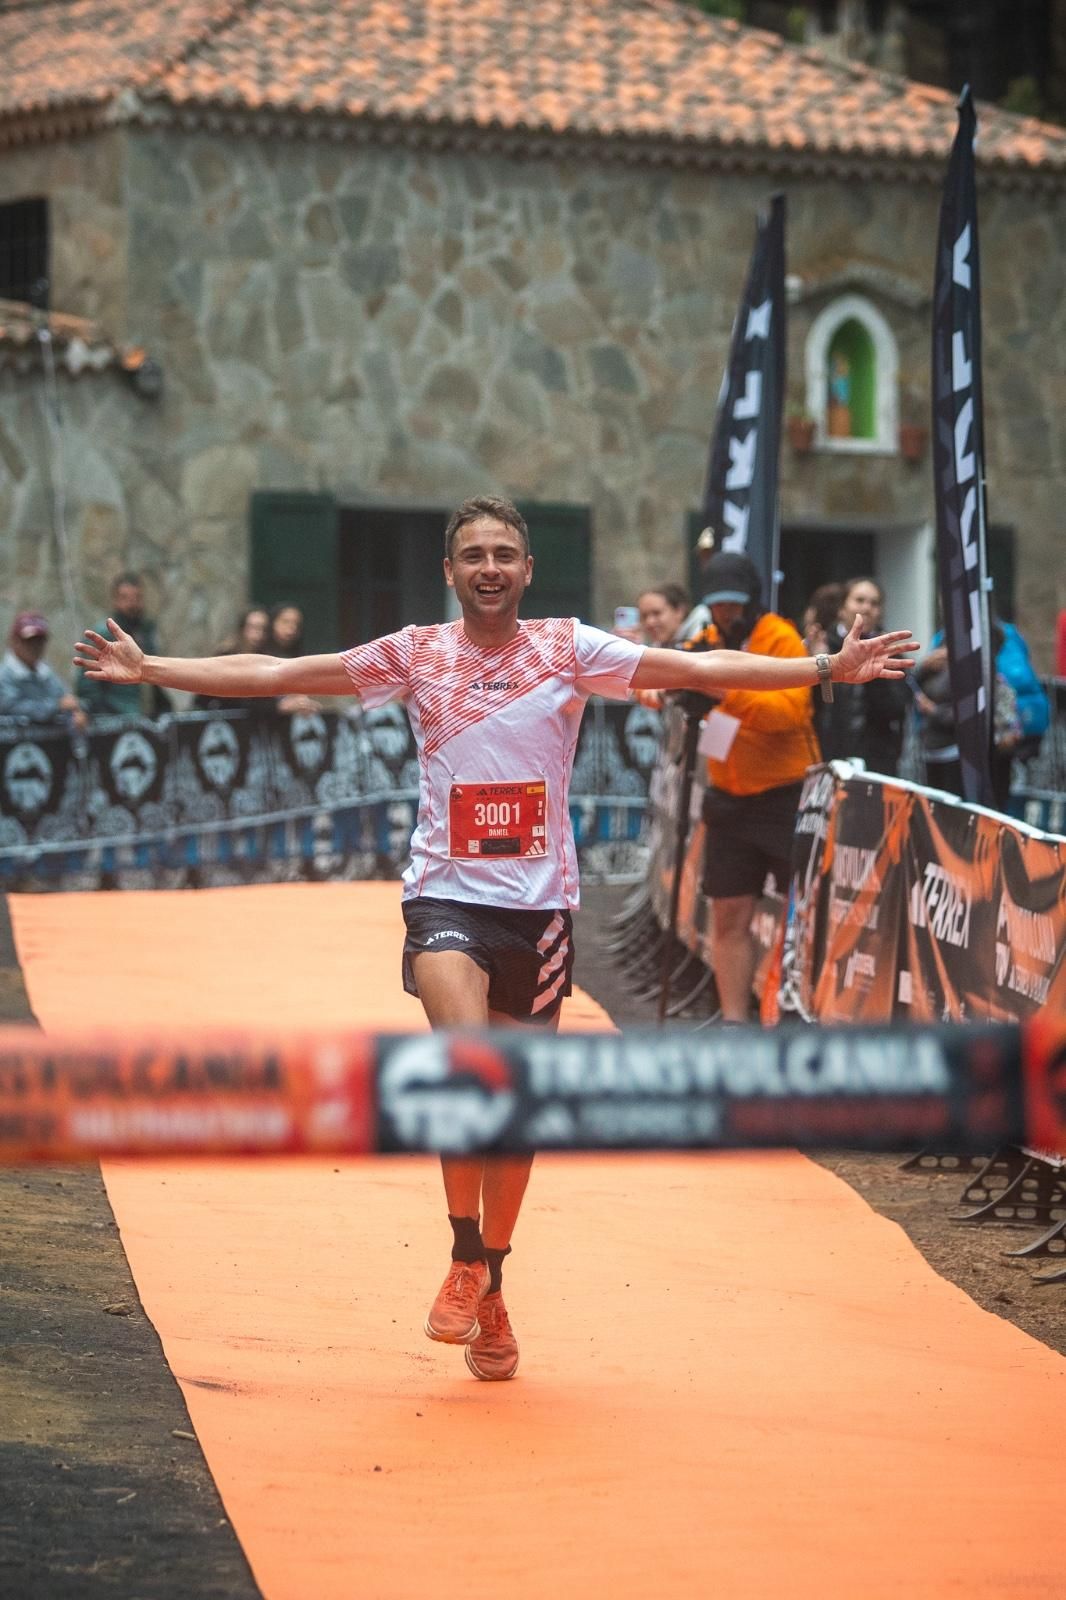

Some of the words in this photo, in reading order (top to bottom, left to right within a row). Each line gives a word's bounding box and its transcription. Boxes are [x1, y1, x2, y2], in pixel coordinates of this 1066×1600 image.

[482, 681, 519, 691] TERREX
[489, 786, 523, 796] TERREX
[474, 802, 520, 826] 3001
[488, 828, 509, 837] DANIEL
